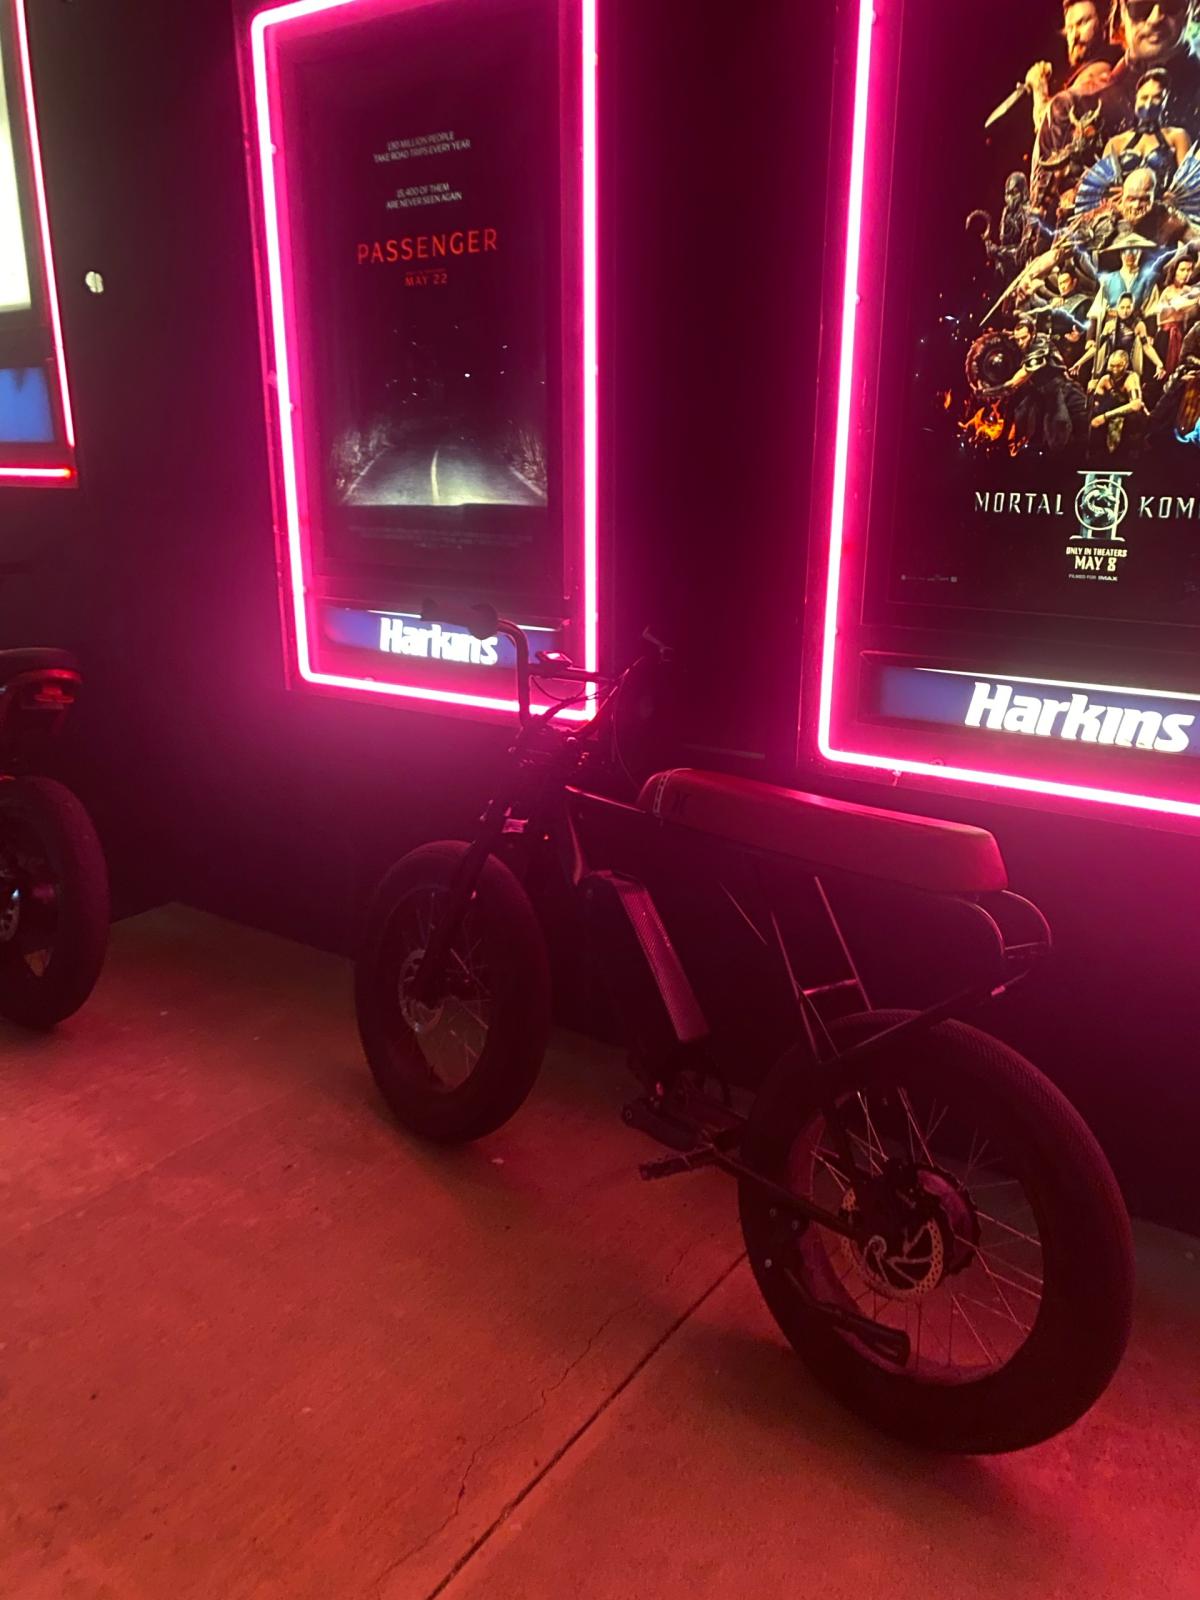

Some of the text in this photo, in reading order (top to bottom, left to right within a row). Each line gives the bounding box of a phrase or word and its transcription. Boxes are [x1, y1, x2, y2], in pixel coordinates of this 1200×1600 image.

[400, 137, 427, 149] MILLION
[428, 131, 455, 144] PEOPLE
[373, 139, 471, 163] TAKE ROAD TRIPS EVERY YEAR
[429, 182, 450, 193] THEM
[386, 191, 463, 210] ARE NEVER SEEN AGAIN
[357, 228, 498, 265] PASSENGER
[404, 273, 448, 287] MAY 22
[974, 491, 1065, 515] MORTAL
[1138, 496, 1200, 519] KOM
[1066, 546, 1128, 558] ONLY IN THEATERS
[1074, 556, 1117, 572] MAY 8
[964, 681, 1195, 753] Harkins
